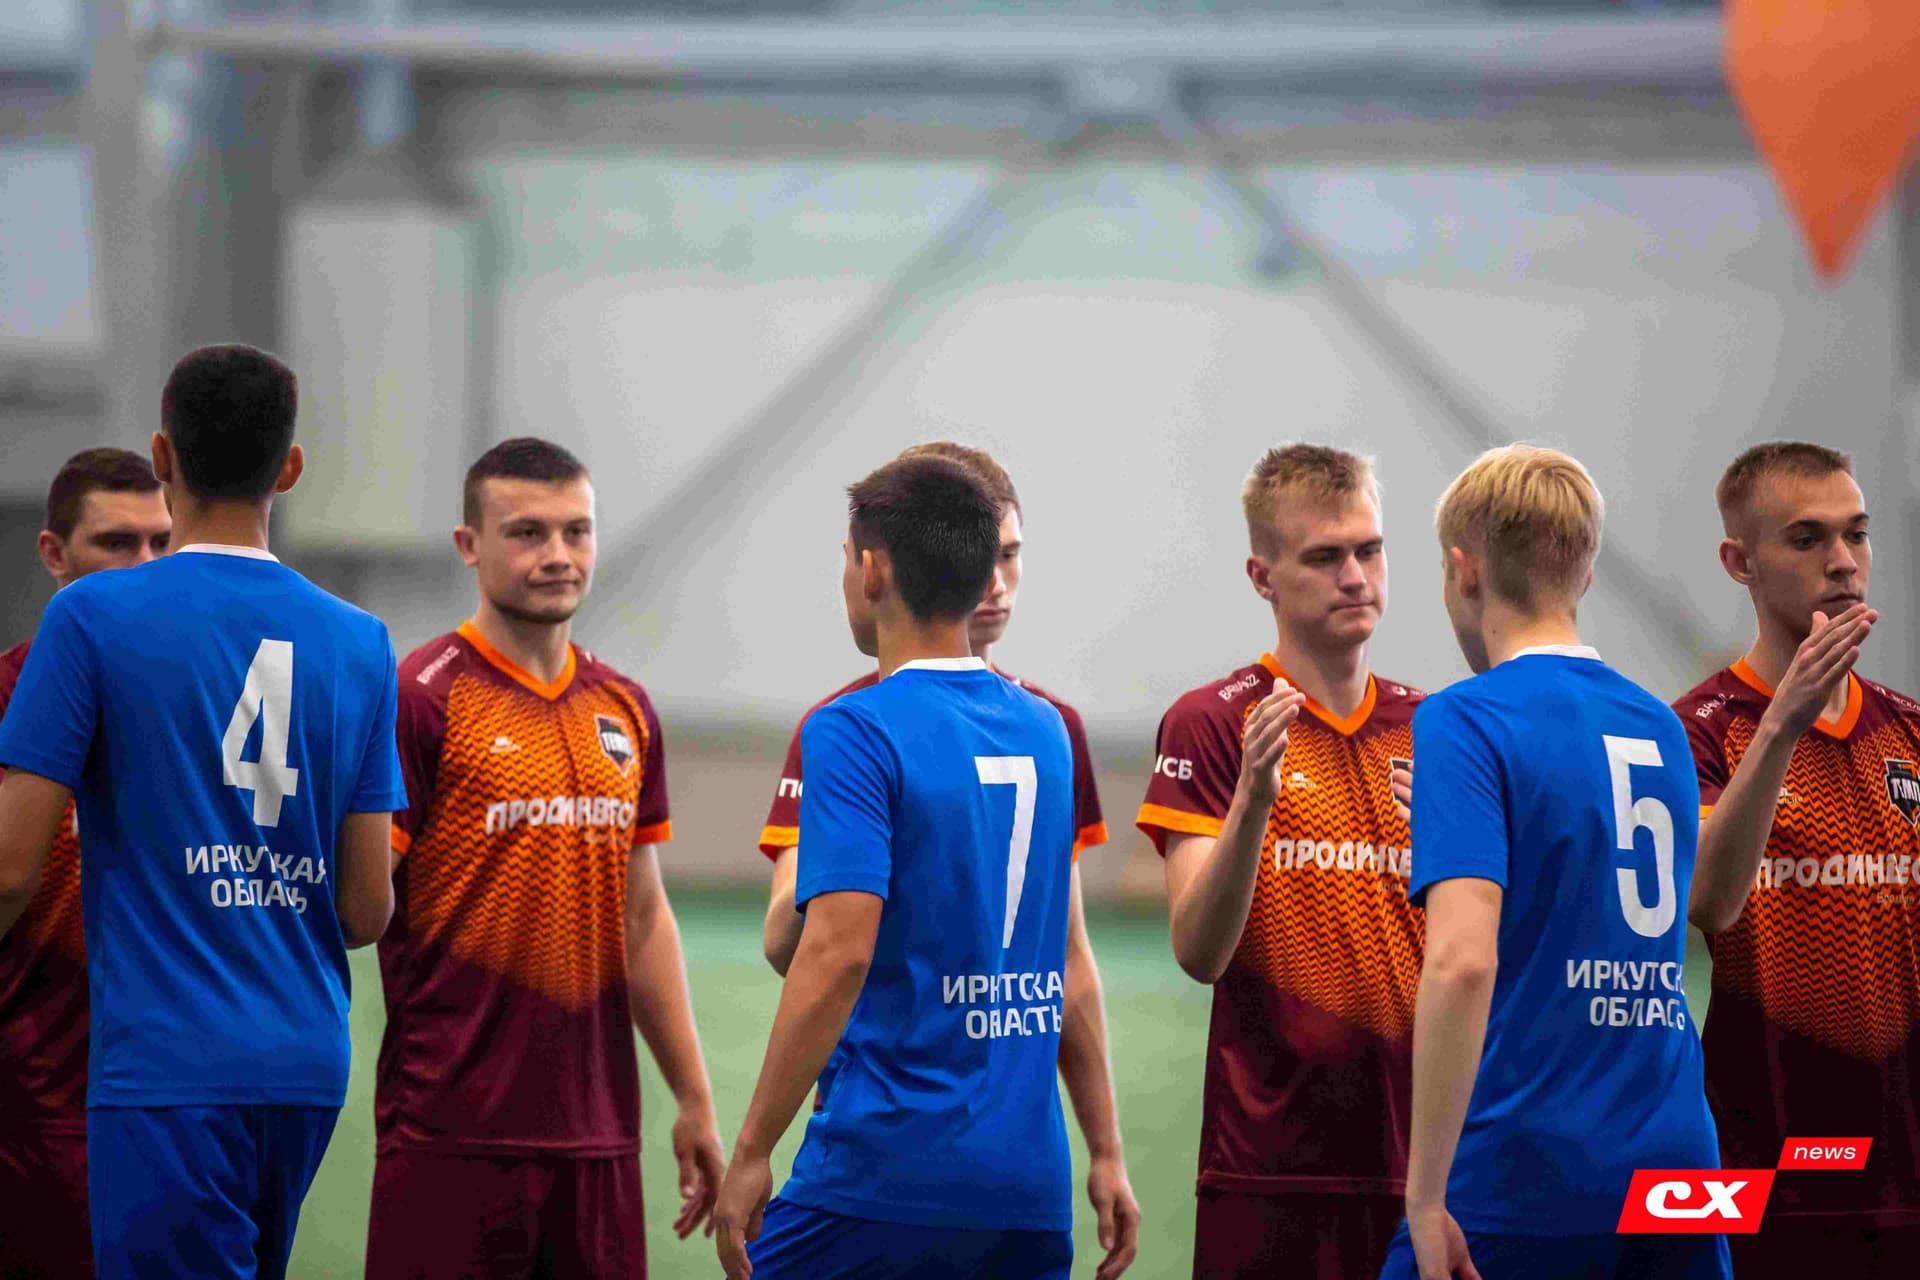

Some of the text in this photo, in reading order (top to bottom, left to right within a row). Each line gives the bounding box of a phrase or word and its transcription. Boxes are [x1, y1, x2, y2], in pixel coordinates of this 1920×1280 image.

[222, 638, 299, 828] 4
[974, 756, 1038, 949] 7
[1602, 735, 1677, 938] 5
